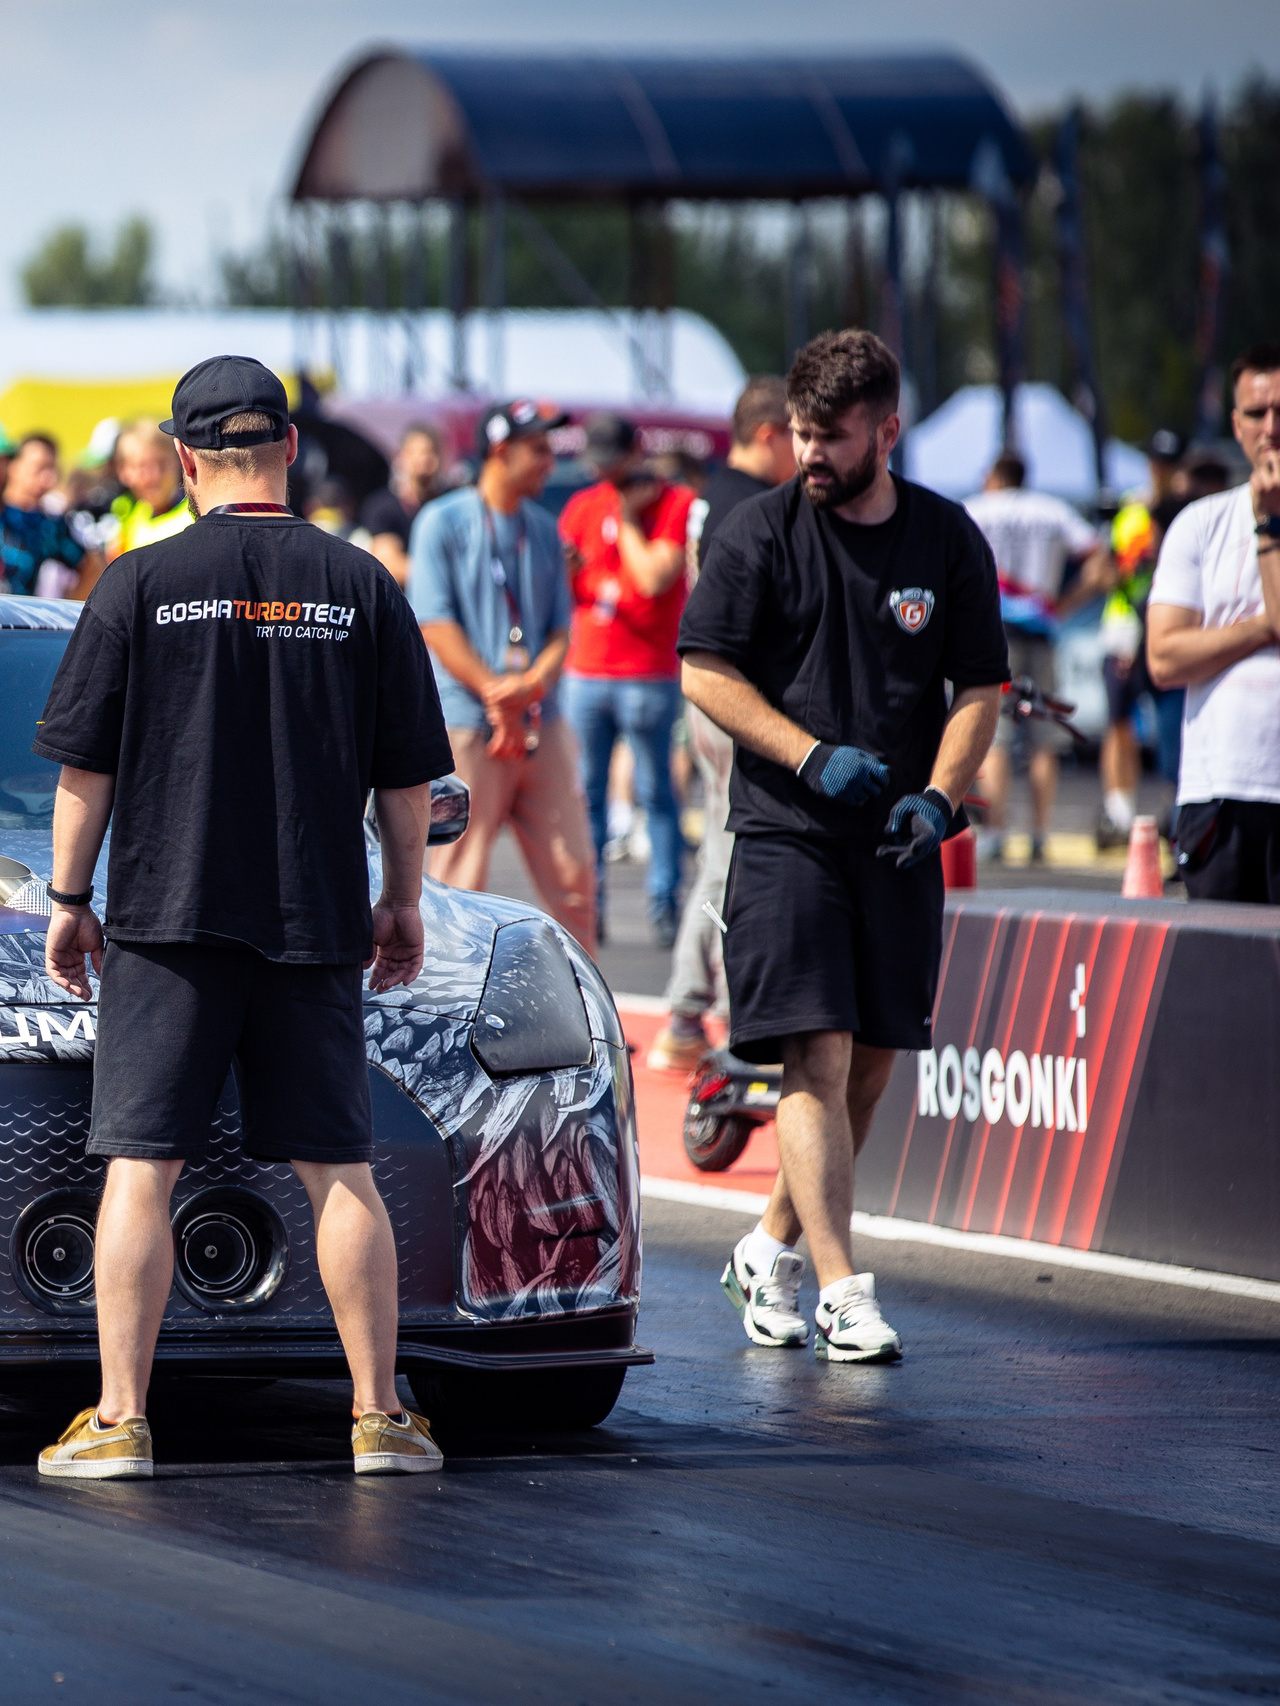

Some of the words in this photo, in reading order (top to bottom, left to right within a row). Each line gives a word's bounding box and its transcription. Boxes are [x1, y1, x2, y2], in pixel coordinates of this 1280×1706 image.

[156, 599, 355, 627] GOSHATURBOTECH
[906, 603, 922, 625] G
[256, 625, 276, 638] TRY
[278, 625, 292, 638] TO
[295, 626, 333, 640] CATCH
[334, 628, 349, 642] UP
[917, 1043, 1087, 1133] ROSGONKI
